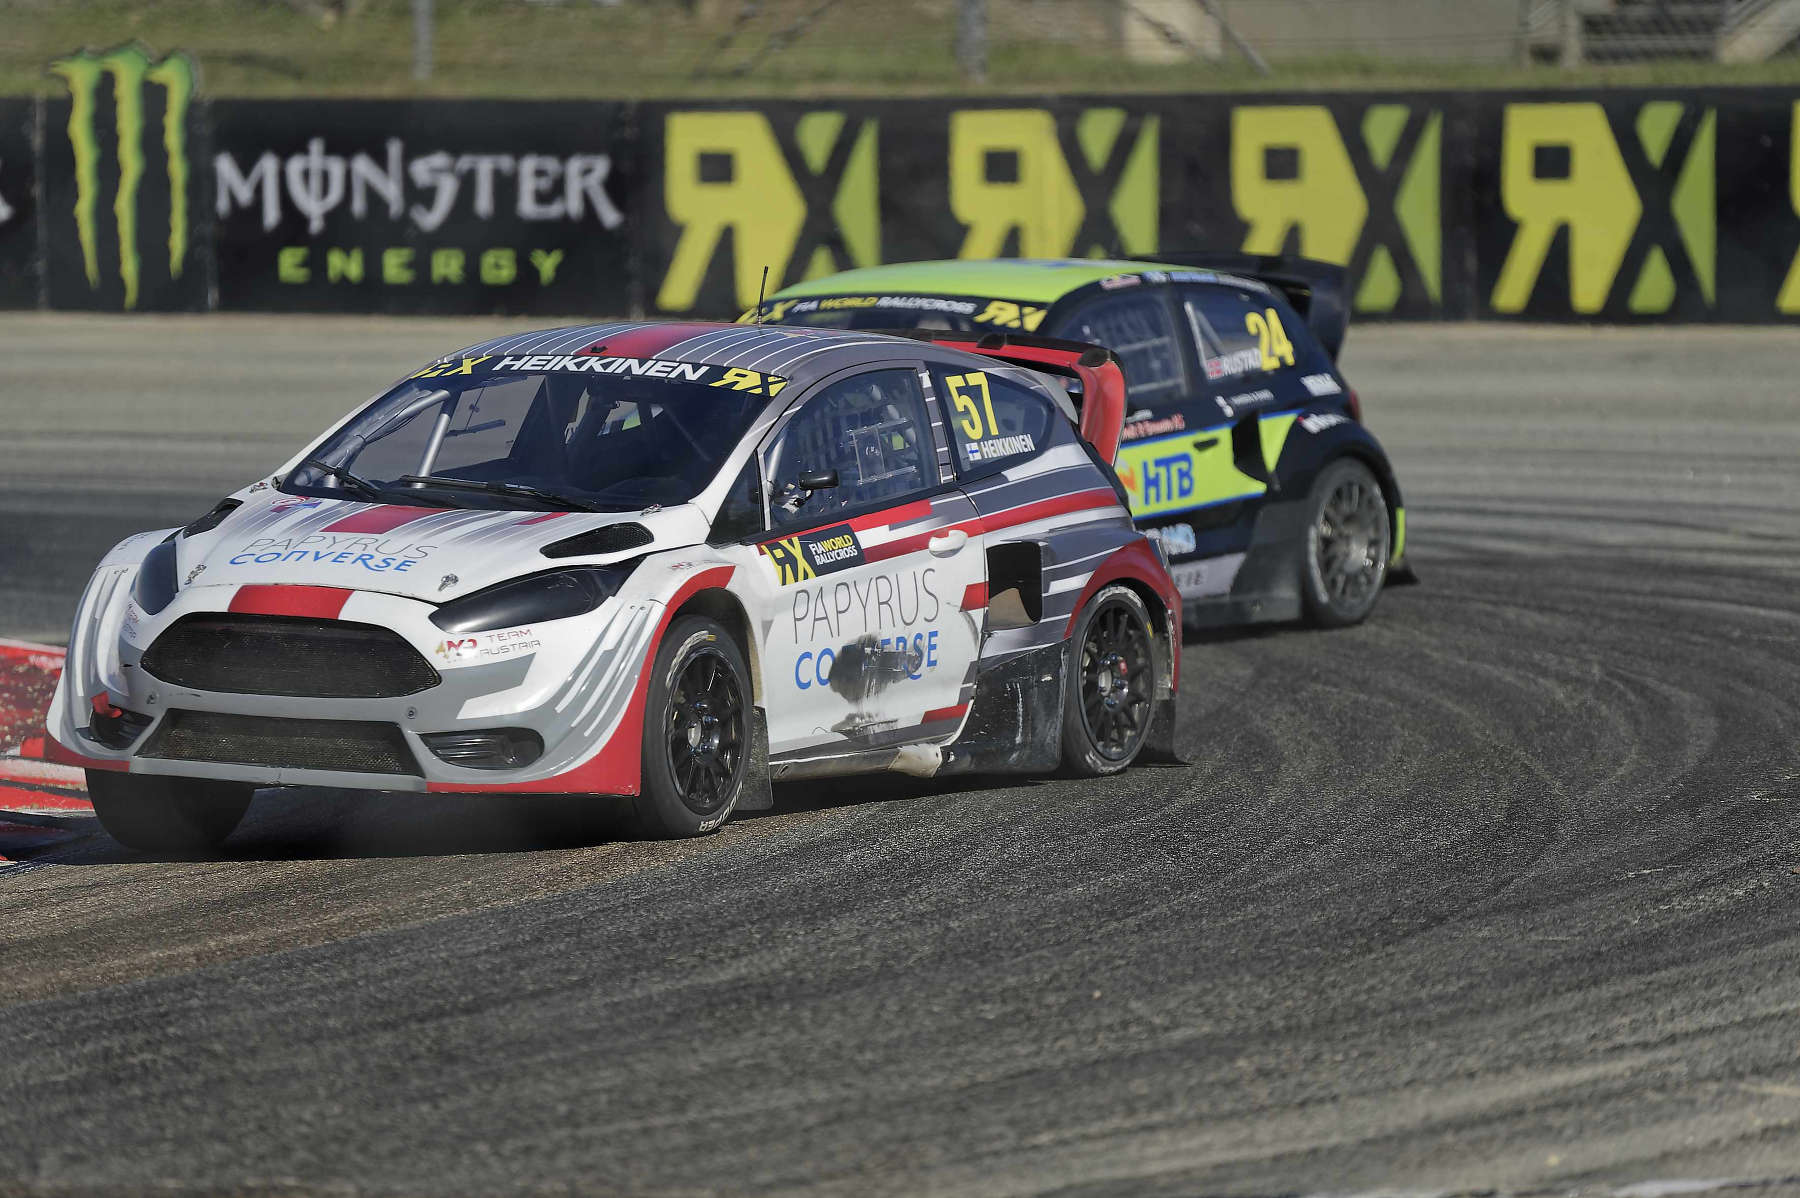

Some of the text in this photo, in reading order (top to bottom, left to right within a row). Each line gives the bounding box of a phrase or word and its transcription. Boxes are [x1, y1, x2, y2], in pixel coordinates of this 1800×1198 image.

[213, 137, 623, 235] MONSTER
[277, 246, 564, 286] ENERGY
[1245, 308, 1296, 372] 24
[492, 355, 711, 382] HEIKKINEN
[945, 371, 999, 440] 57
[980, 433, 1036, 459] HEIKKINEN
[1142, 452, 1195, 506] HTB
[241, 535, 439, 560] PAPYRUS
[814, 545, 858, 566] RALLYCROSS
[792, 567, 940, 645] PAPYRUS
[479, 639, 541, 656] AUSTRIA
[485, 628, 534, 644] TEAM
